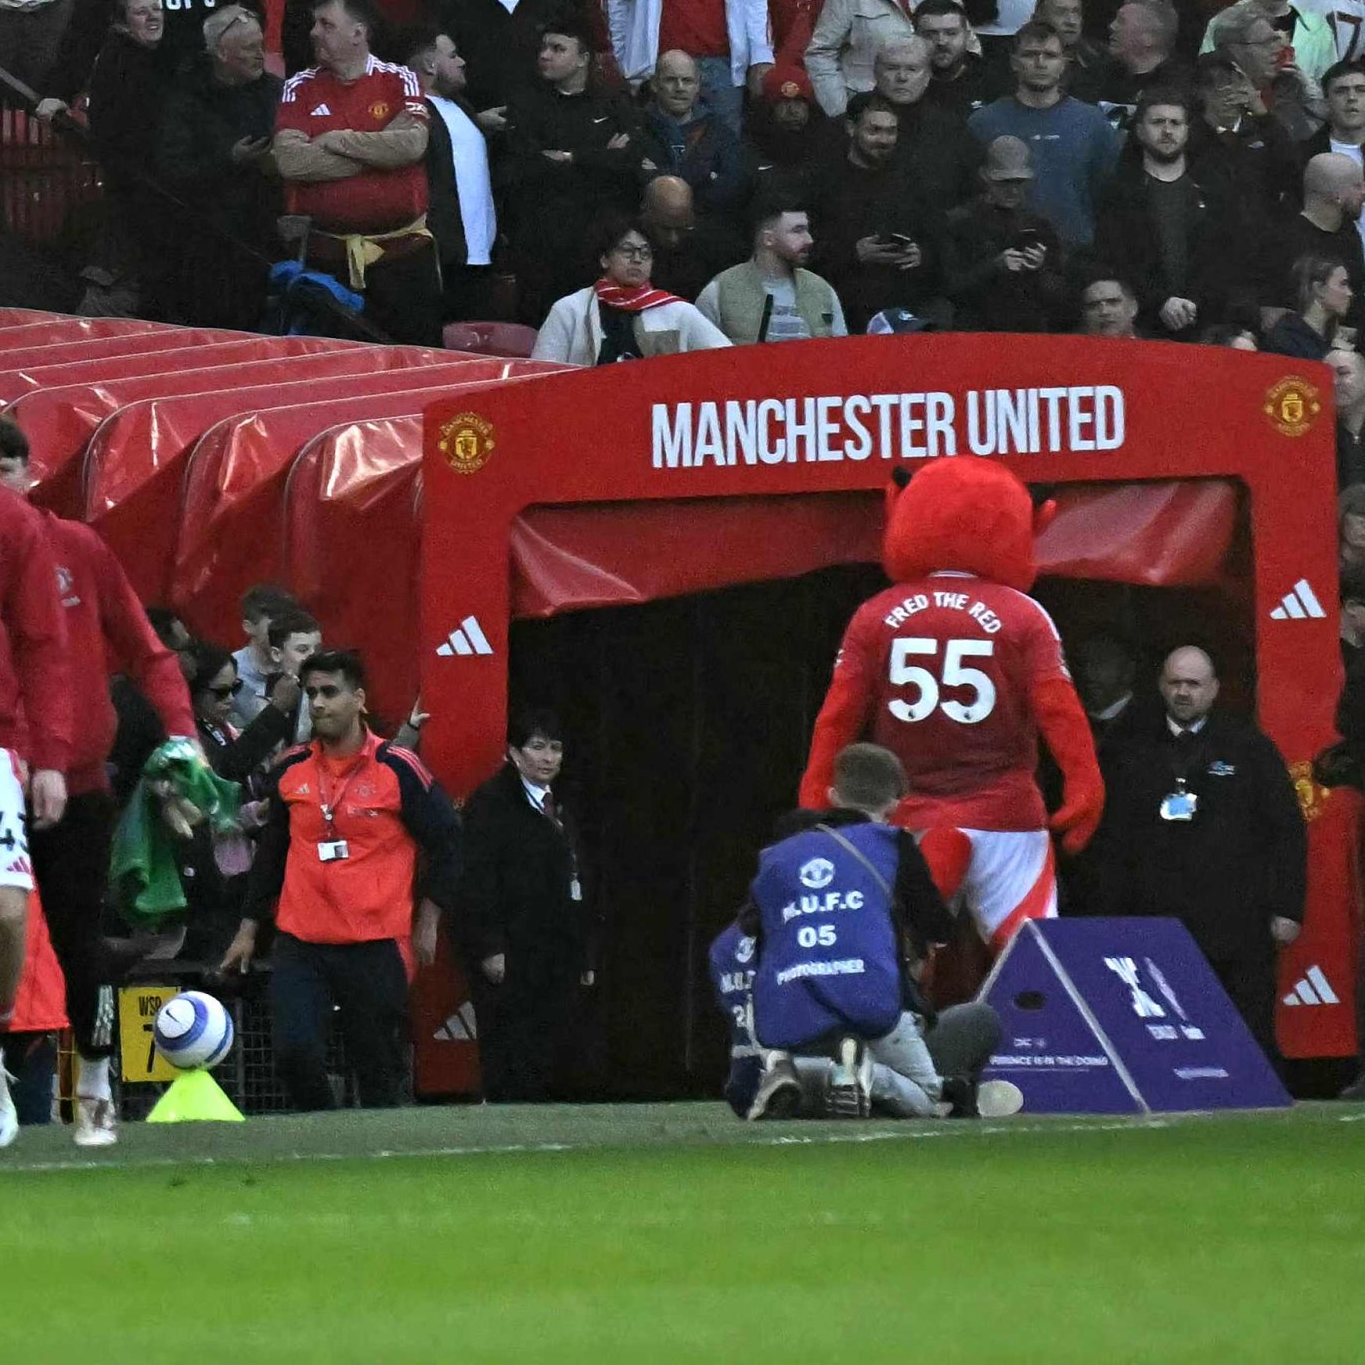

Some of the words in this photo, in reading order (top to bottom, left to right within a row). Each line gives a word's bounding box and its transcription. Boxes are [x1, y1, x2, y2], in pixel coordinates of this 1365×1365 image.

[651, 391, 957, 469] MANCHESTER
[967, 384, 1125, 456] UNITED
[884, 594, 930, 630] FRED
[933, 591, 970, 611] THE
[968, 600, 1003, 634] RED
[887, 637, 997, 724] 55
[797, 924, 838, 948] 05
